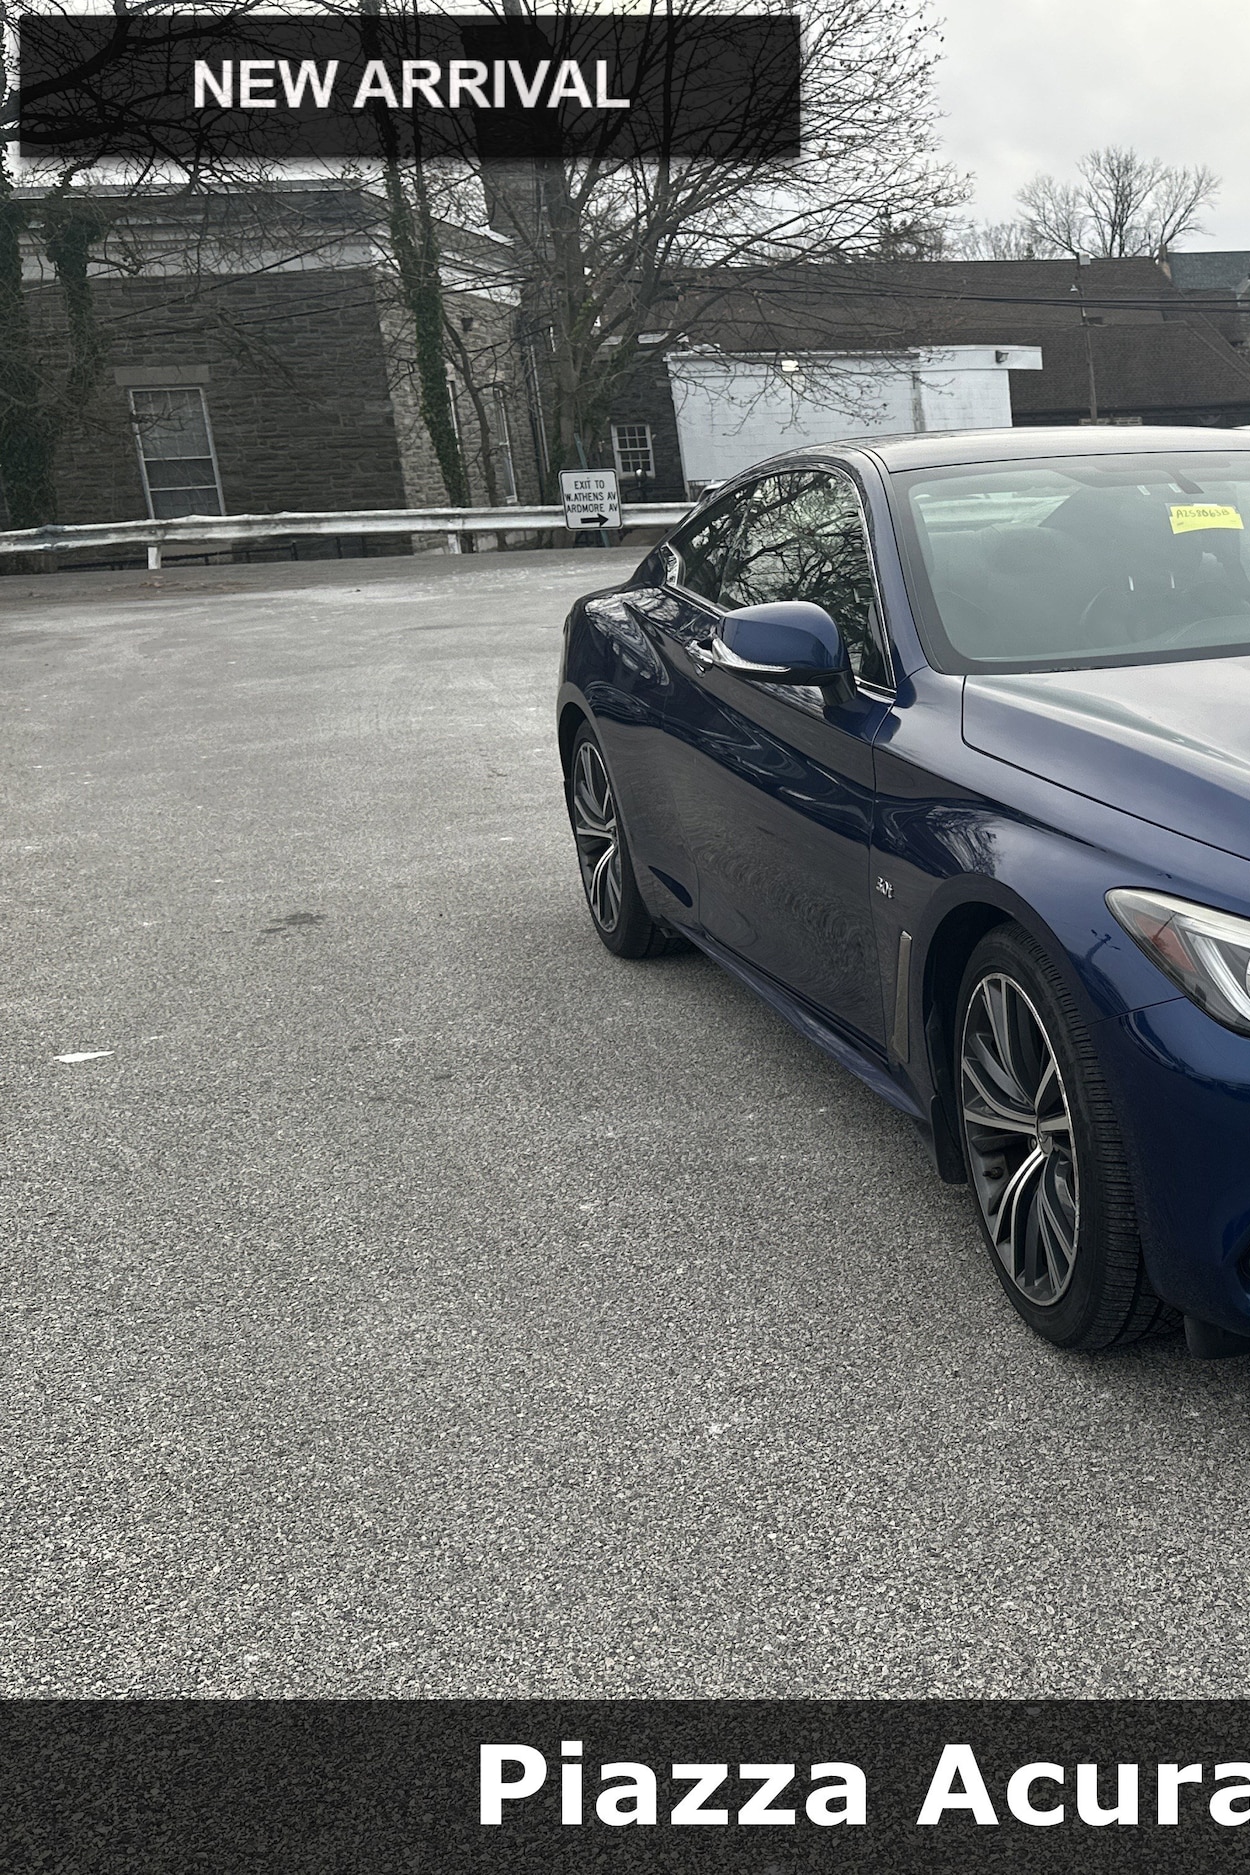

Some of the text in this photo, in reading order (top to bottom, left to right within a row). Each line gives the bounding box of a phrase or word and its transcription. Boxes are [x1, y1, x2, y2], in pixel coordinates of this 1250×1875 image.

[574, 479, 605, 490] EXIT TO
[565, 491, 617, 502] W.ATHENS AV
[567, 503, 618, 514] ARDMORE AV
